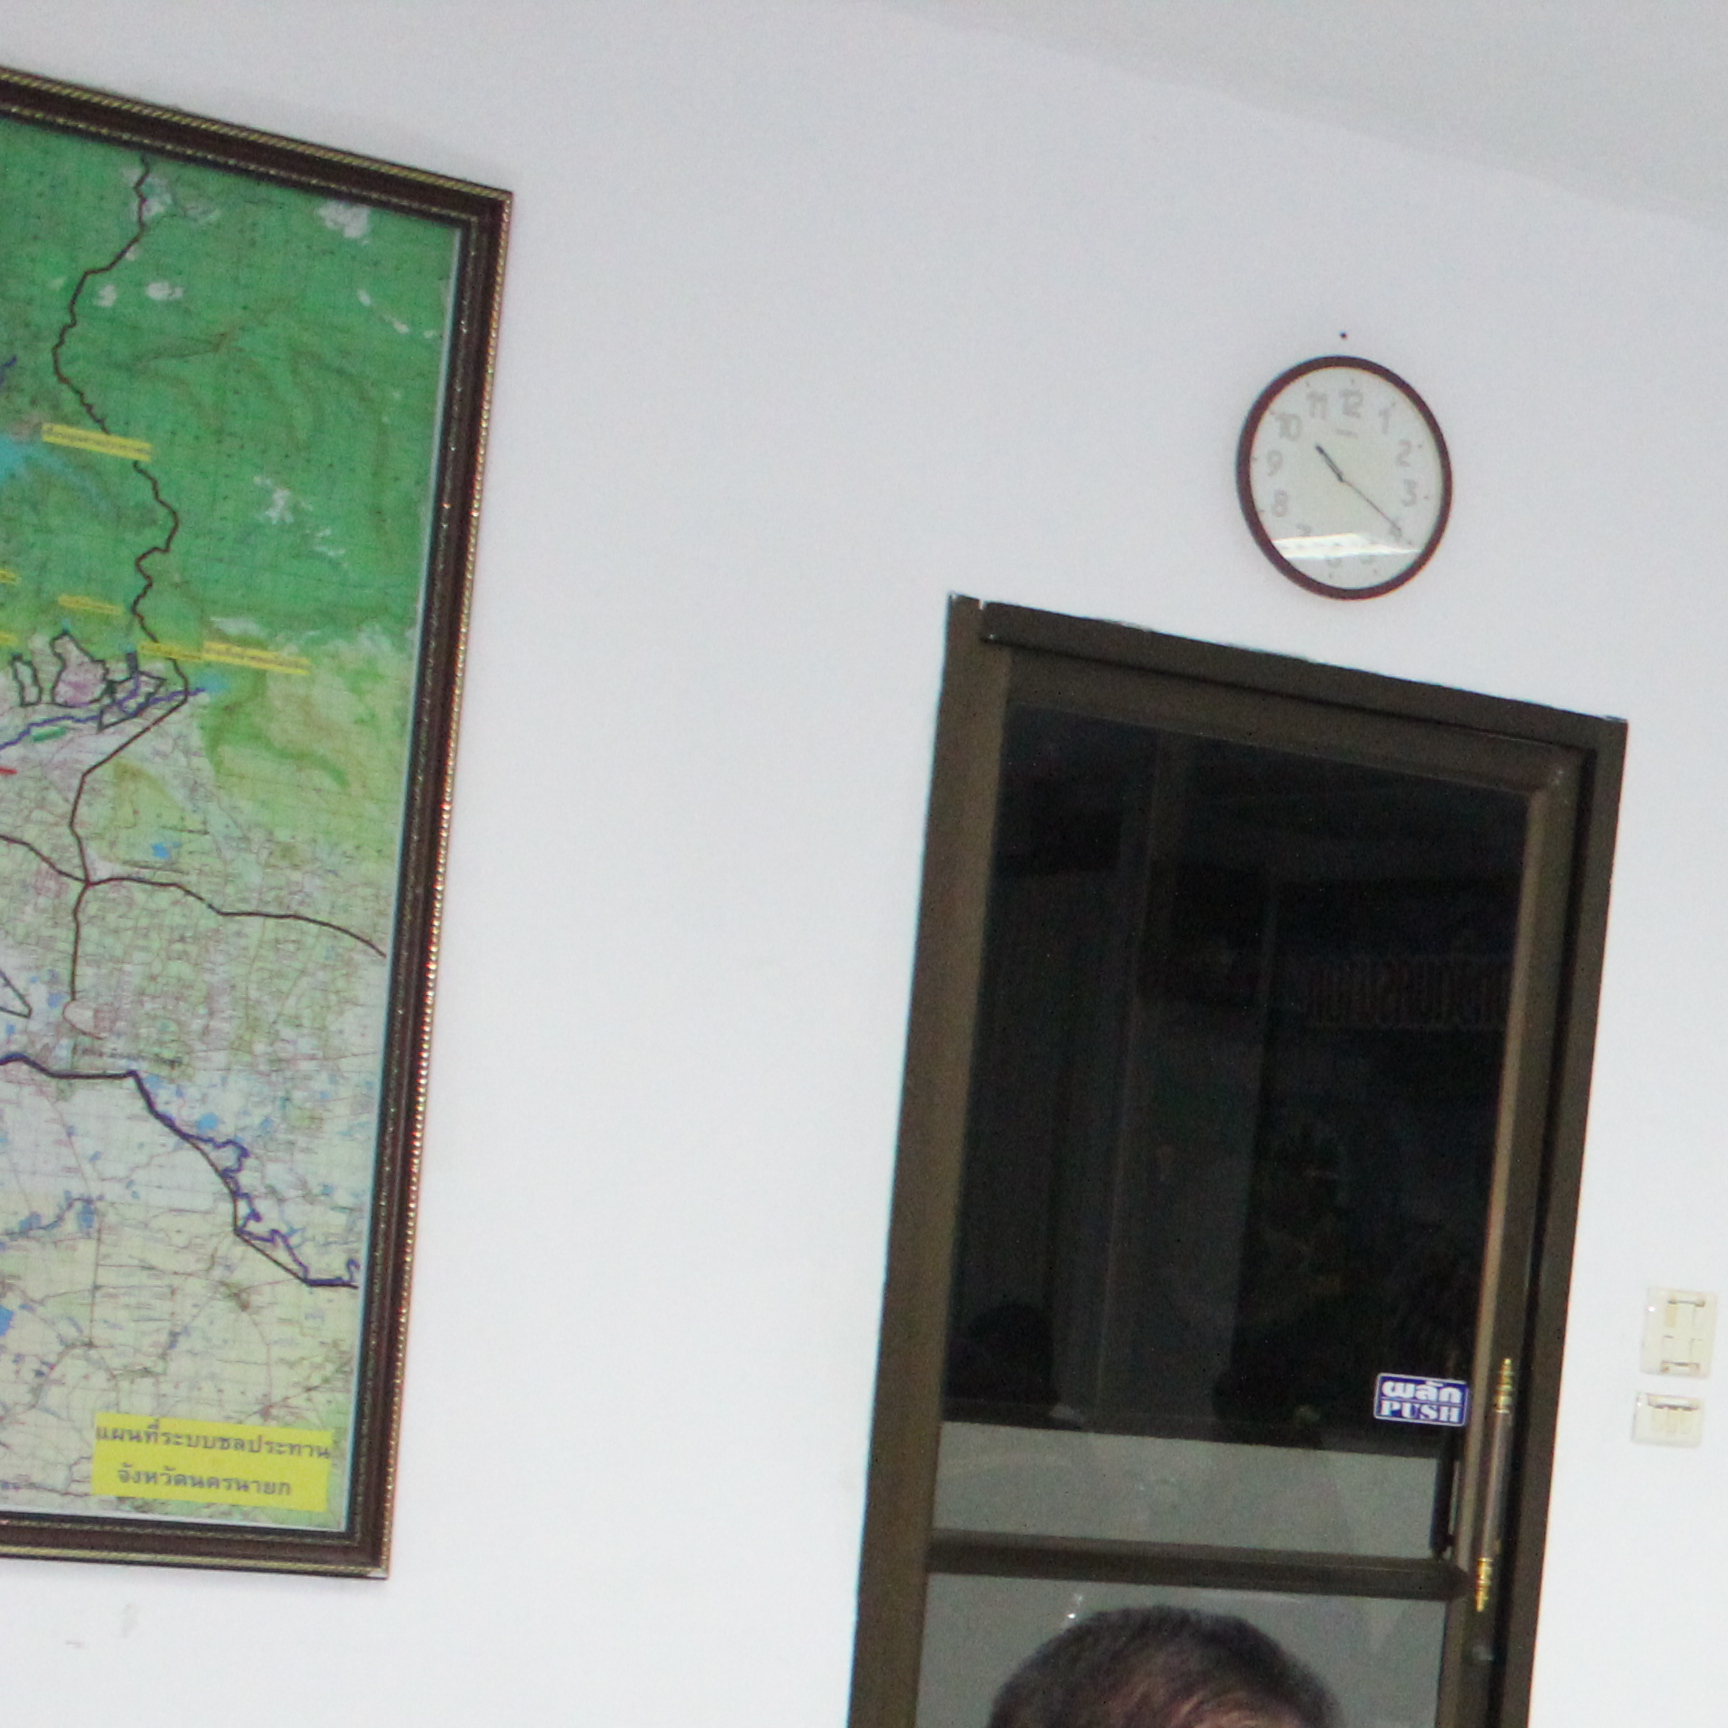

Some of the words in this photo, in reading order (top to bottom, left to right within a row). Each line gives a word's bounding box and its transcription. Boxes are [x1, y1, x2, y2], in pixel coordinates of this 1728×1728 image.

[1381, 1380, 1462, 1403] ผลัก
[1381, 1400, 1460, 1422] PUSH
[96, 1418, 331, 1459] แผนที่ระบบชลประทาน
[117, 1462, 291, 1496] จังหวัดนครนายก
